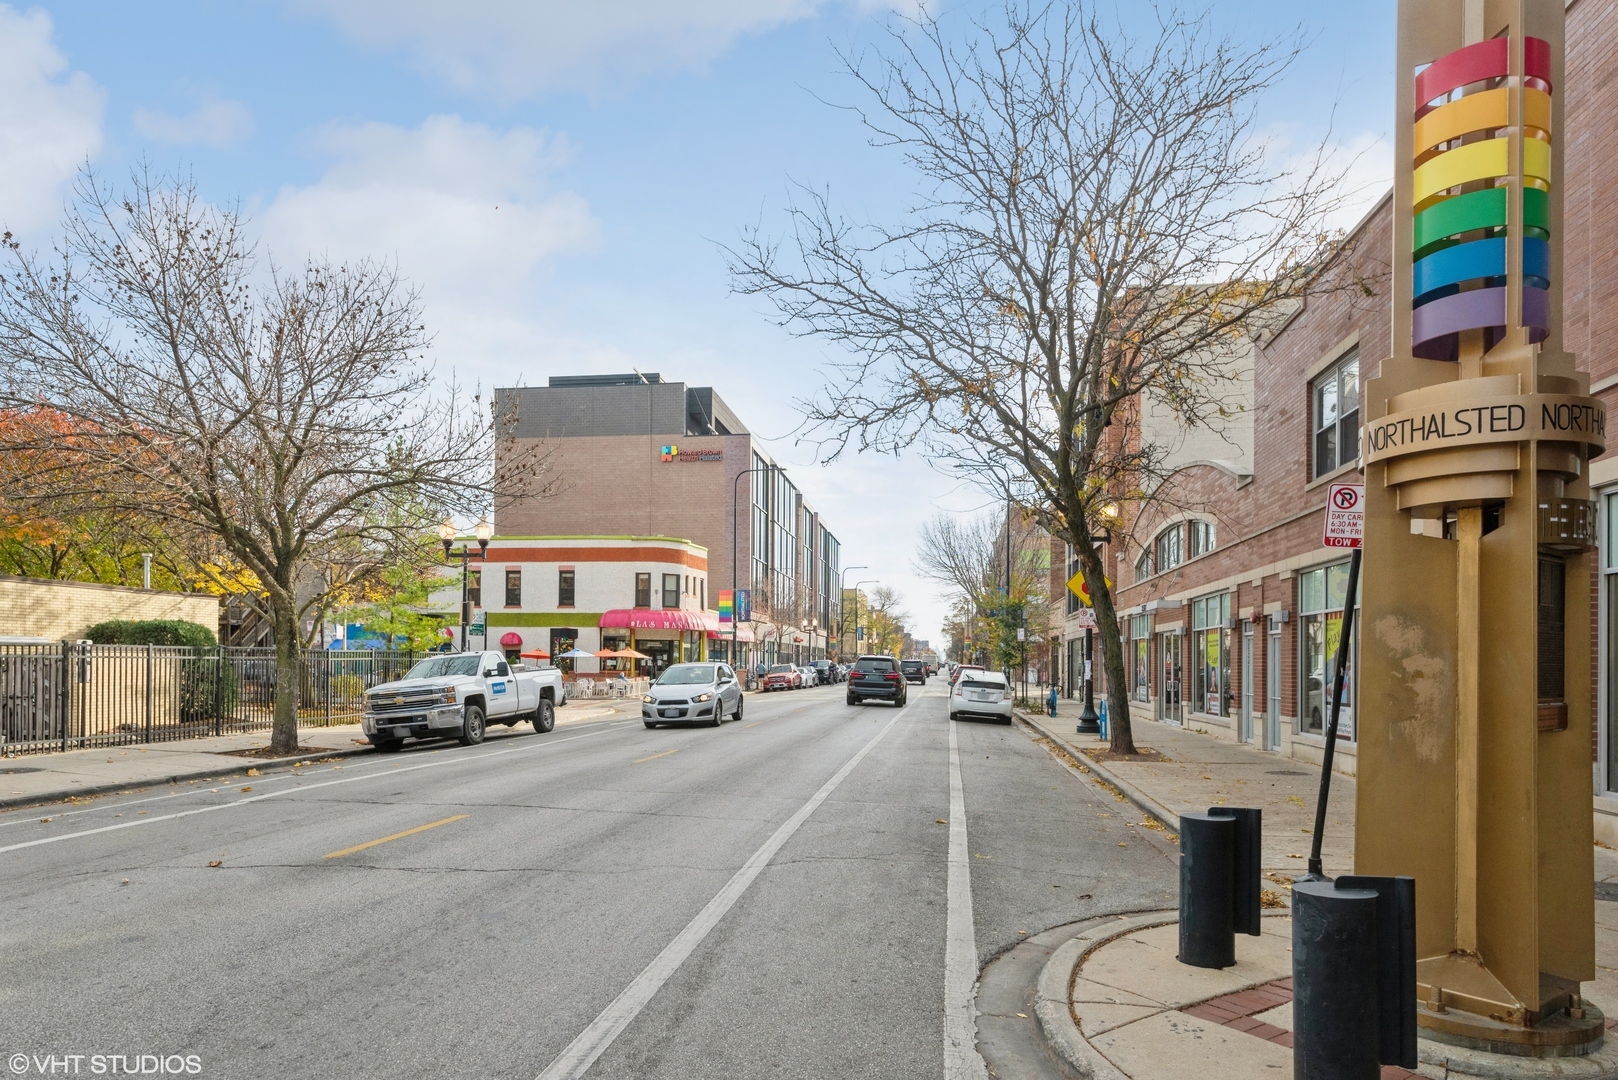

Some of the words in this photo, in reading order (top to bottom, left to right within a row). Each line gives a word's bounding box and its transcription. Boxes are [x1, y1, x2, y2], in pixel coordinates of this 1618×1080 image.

[1368, 404, 1525, 454] NORTHALSTED
[1328, 537, 1352, 547] TOW
[636, 620, 656, 629] LAS
